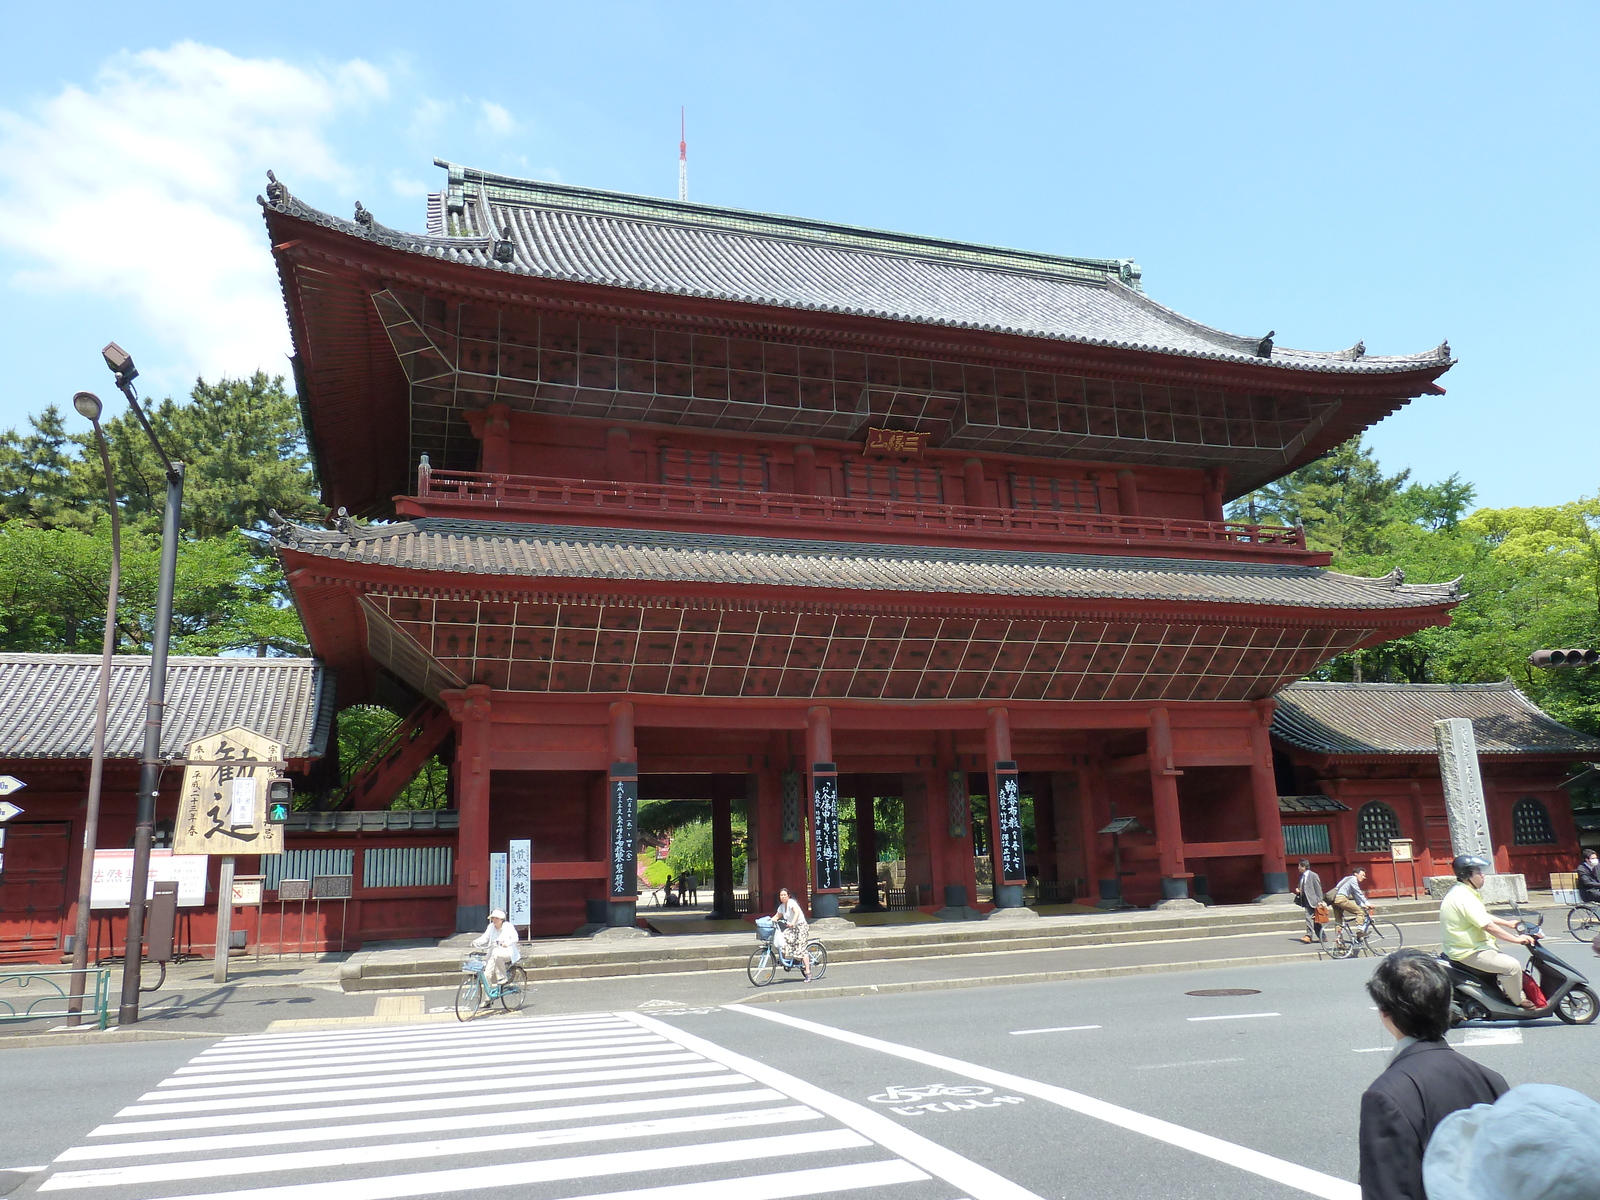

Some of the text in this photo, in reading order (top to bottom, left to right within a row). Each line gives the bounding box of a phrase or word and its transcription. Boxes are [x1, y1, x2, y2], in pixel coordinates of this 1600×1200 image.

[187, 770, 202, 837] 平成二十三年春
[512, 848, 528, 913] 煎茶教室
